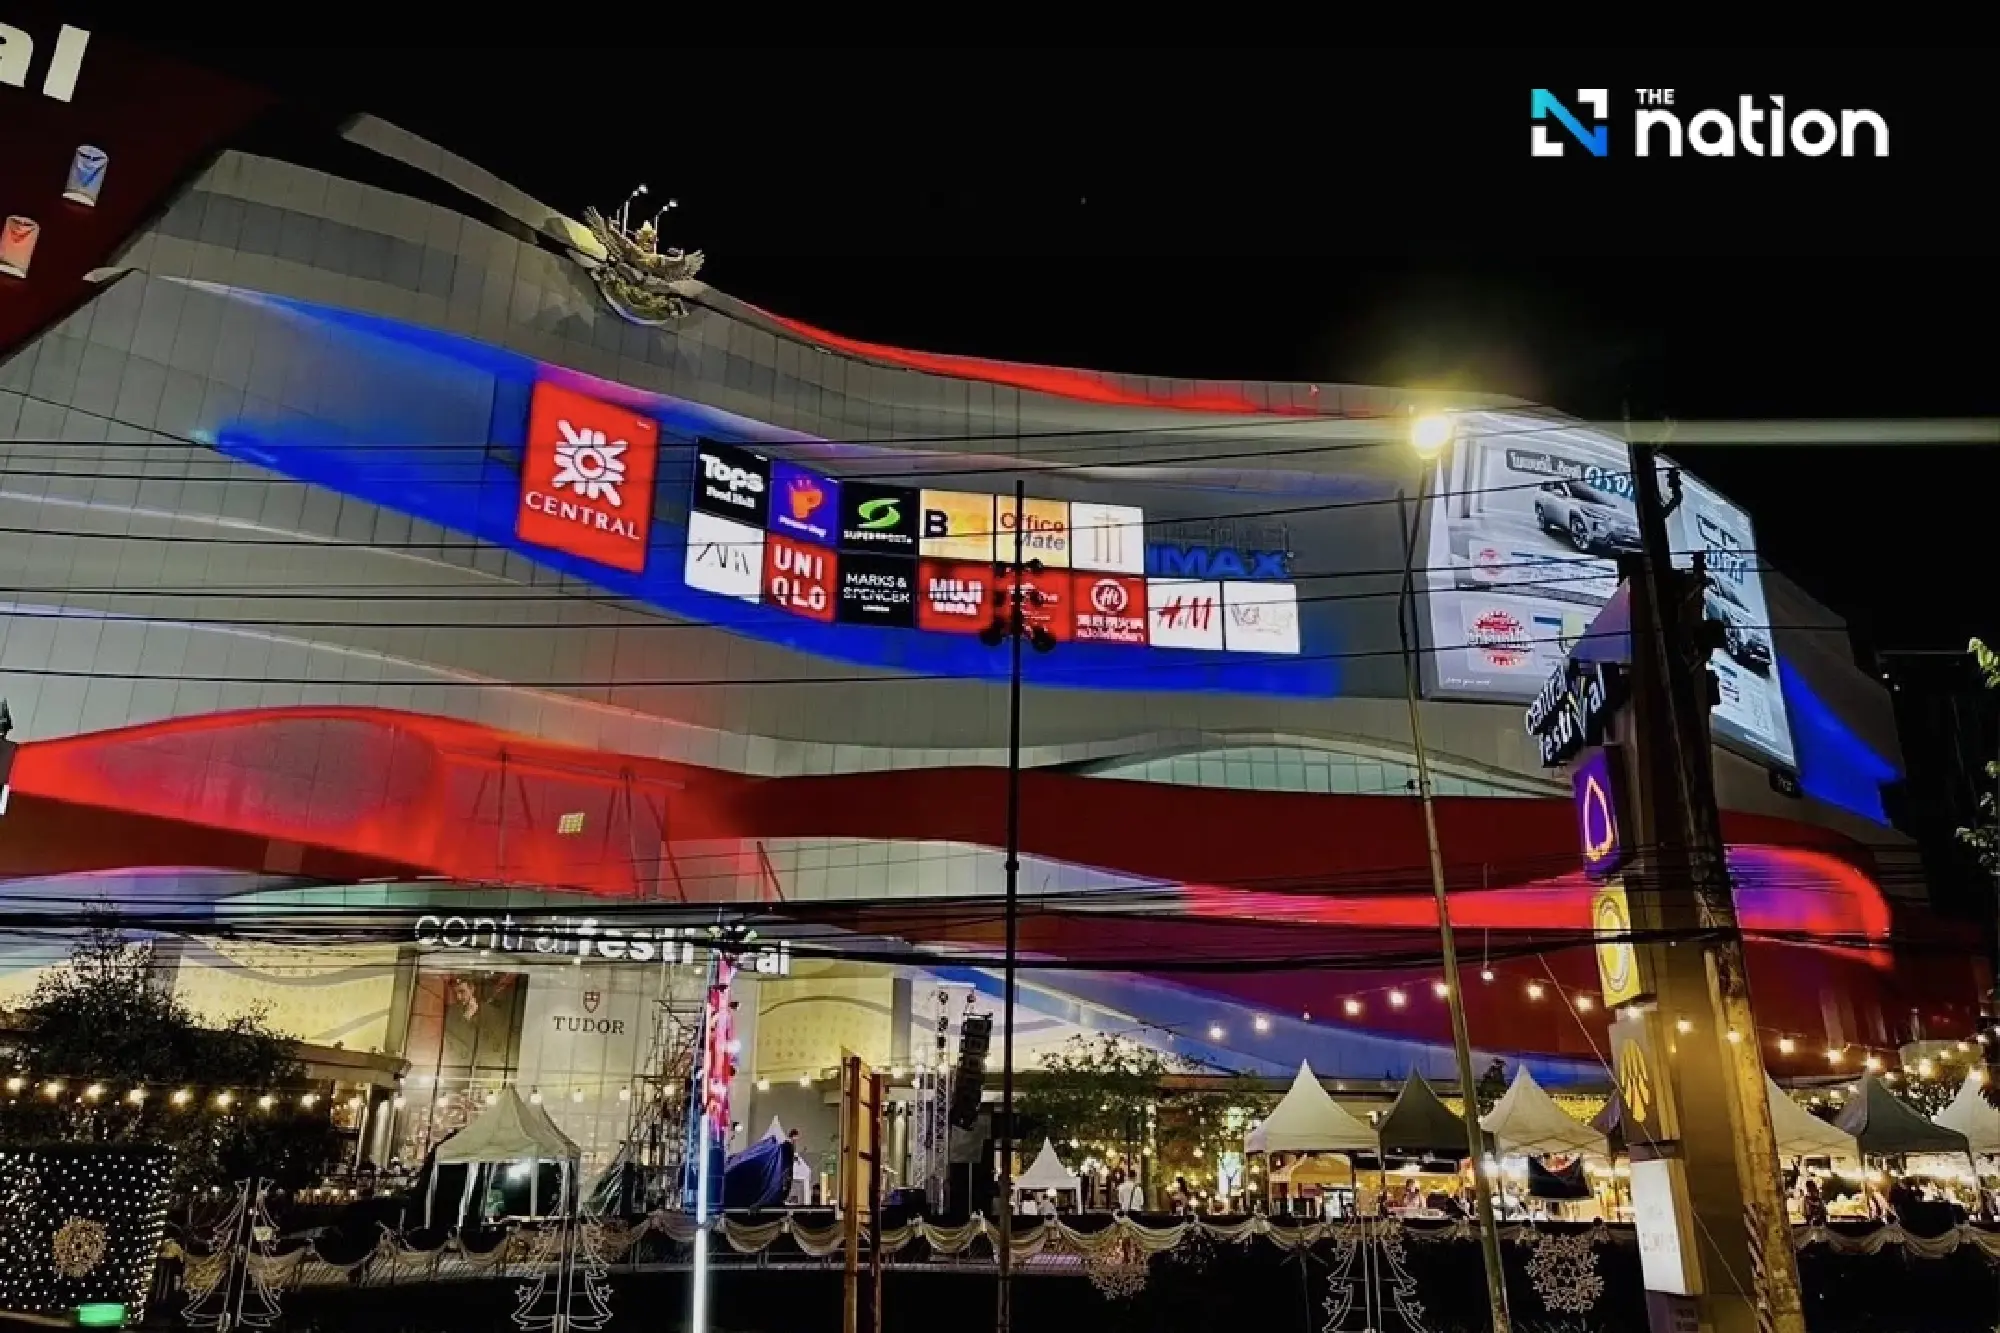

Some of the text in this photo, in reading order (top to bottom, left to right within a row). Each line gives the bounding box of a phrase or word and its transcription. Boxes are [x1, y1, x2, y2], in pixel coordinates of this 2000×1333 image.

[525, 491, 641, 540] CENTRAL
[774, 545, 823, 580] UNI
[1146, 541, 1286, 577] IMAX
[771, 576, 826, 610] QLO
[845, 572, 895, 588] MARKS
[553, 1015, 626, 1036] TUDOR
